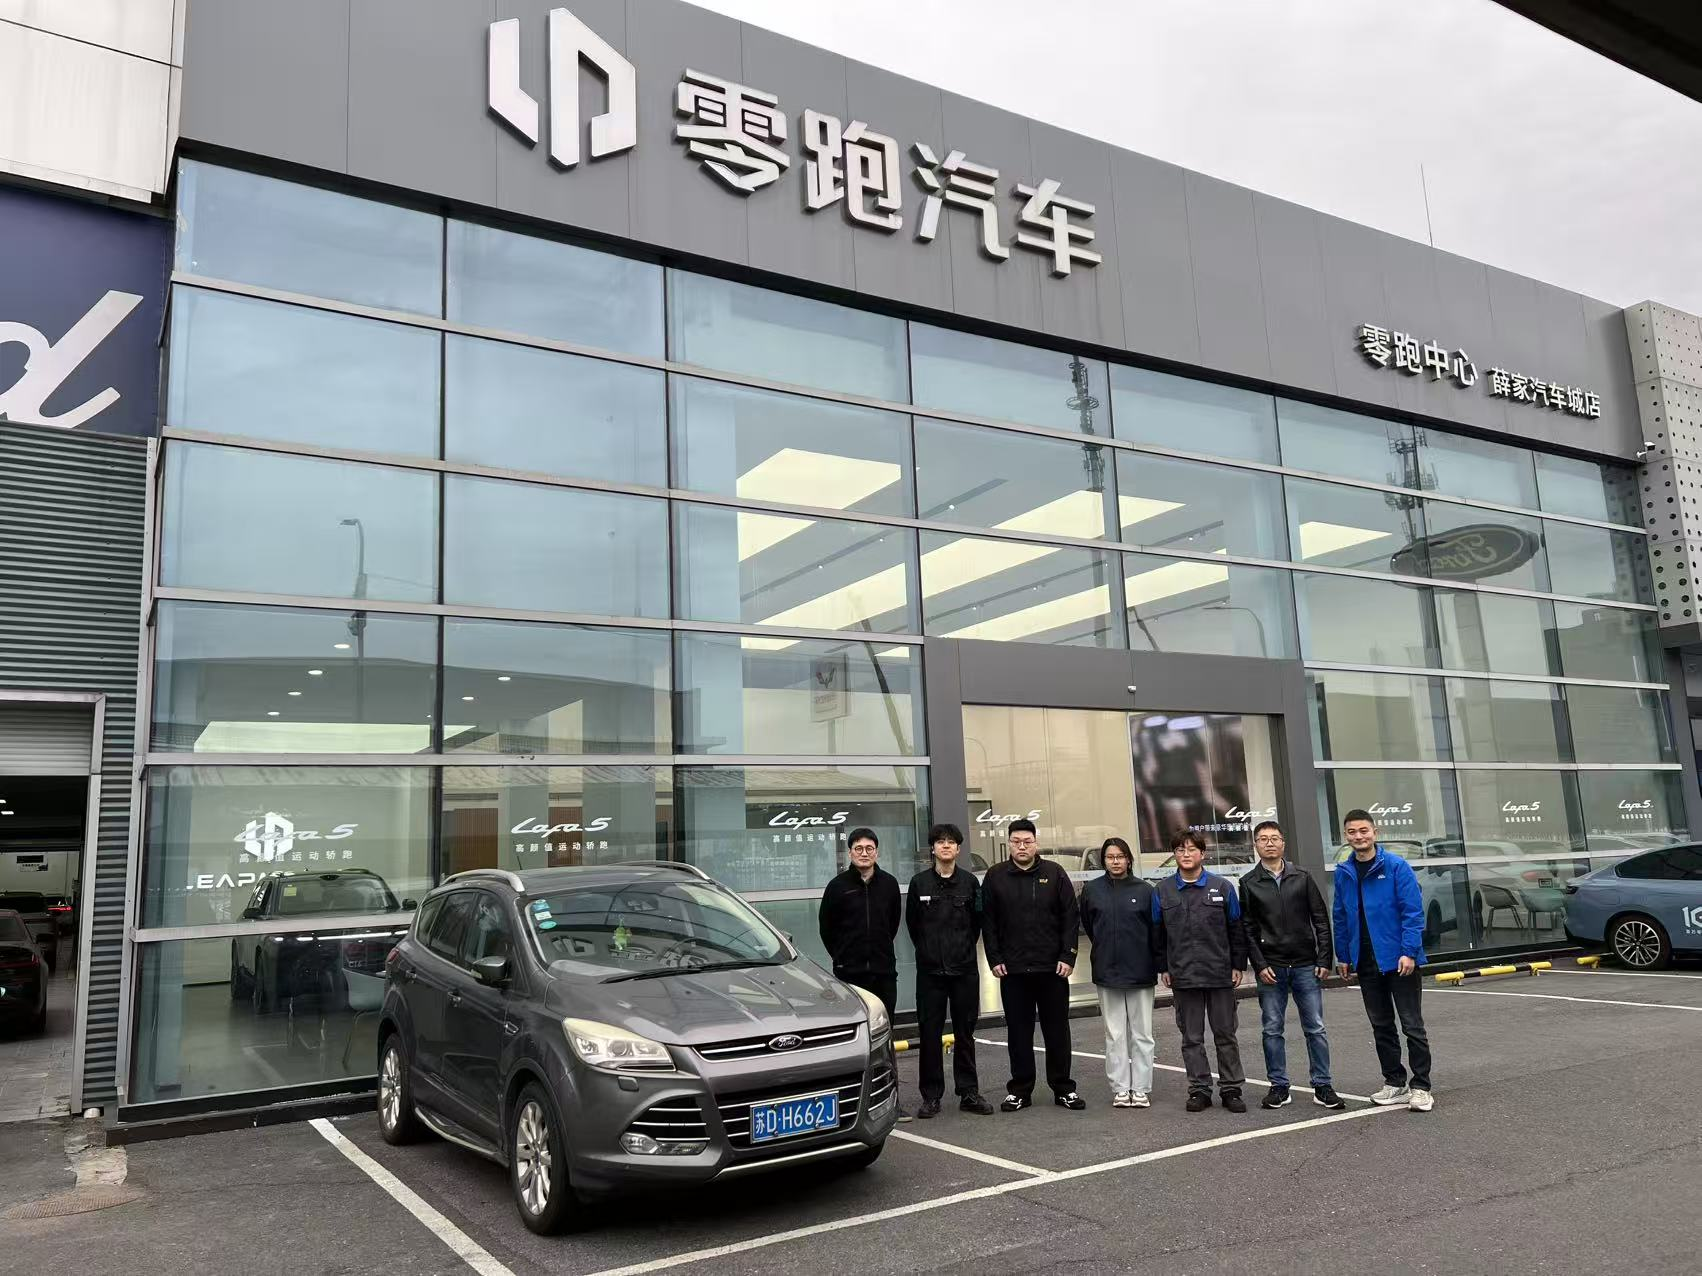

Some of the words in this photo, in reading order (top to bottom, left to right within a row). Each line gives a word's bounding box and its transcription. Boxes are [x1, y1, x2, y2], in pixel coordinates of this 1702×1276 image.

[676, 68, 1102, 278] 零跑汽车
[1359, 323, 1479, 387] 零跑中心
[1489, 366, 1601, 418] 薛家汽车城店
[516, 841, 609, 853] 高颜值运动轿跑
